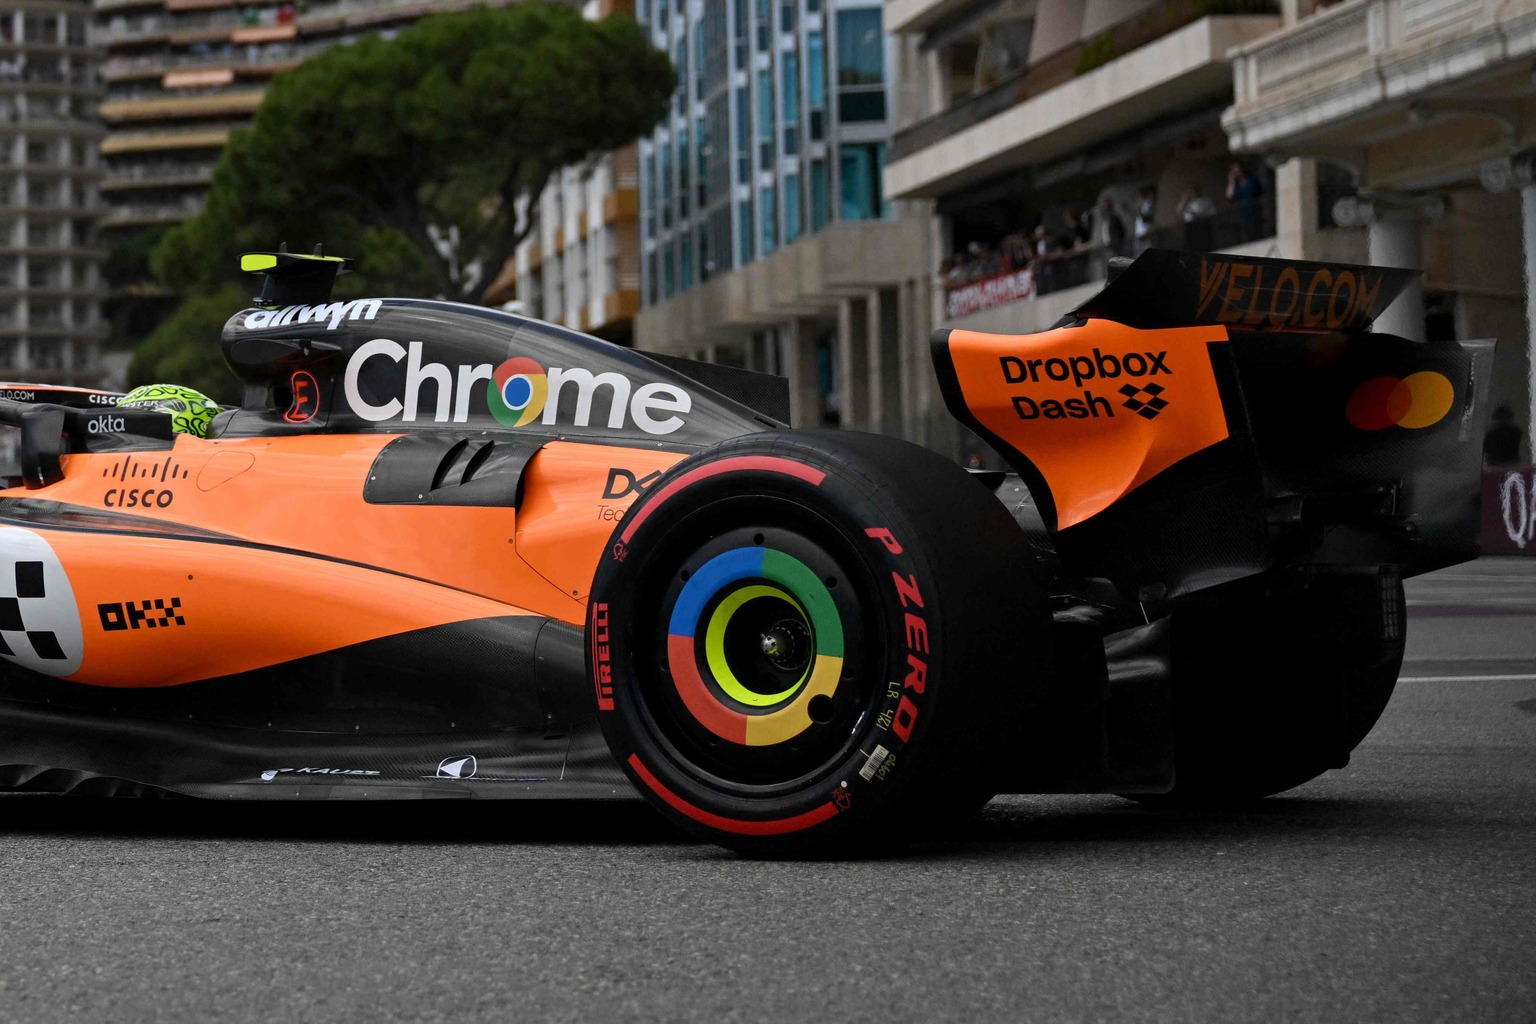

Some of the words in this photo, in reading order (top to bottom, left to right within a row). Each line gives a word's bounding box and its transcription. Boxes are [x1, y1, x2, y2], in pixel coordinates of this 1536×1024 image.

[1196, 260, 1383, 330] VELO.COM
[244, 299, 383, 330] allwyn
[999, 347, 1174, 388] Dropbox
[1010, 389, 1114, 421] Dash
[87, 415, 126, 434] okta
[103, 489, 174, 508] CISCO
[864, 527, 904, 555] P
[891, 570, 930, 743] ZERO
[591, 601, 615, 711] PIRELLI
